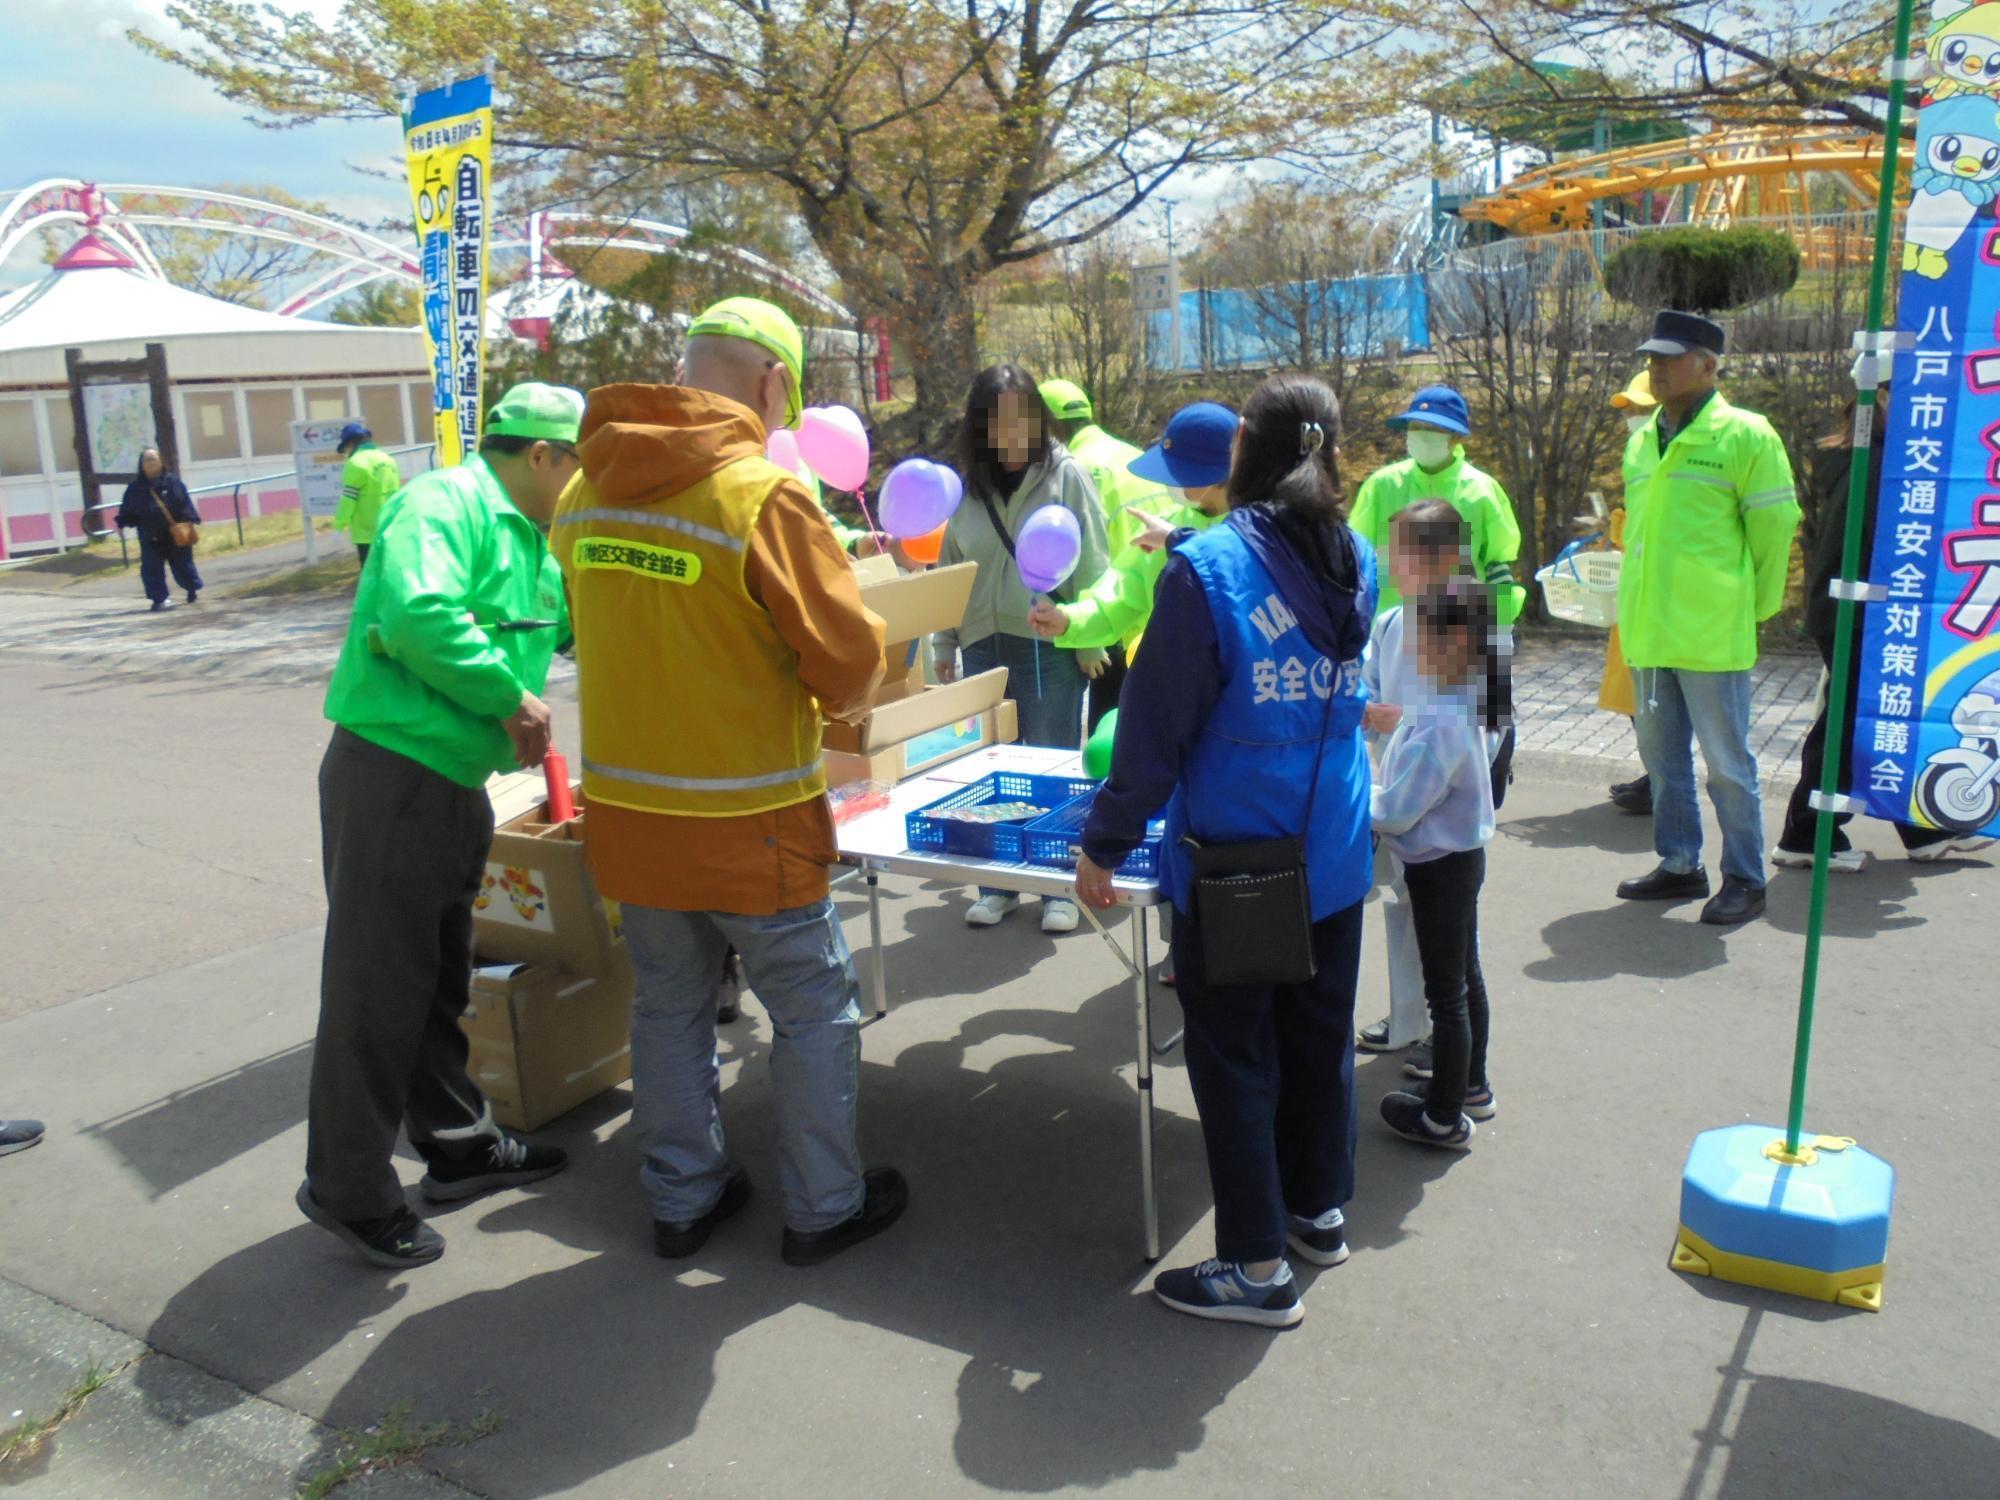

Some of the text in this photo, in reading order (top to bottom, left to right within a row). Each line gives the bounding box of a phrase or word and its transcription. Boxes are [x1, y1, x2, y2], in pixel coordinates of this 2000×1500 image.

[577, 544, 688, 578] 地区交通安全協会
[1869, 305, 1953, 795] 八戸市交通安全対策協議会
[1247, 593, 1299, 646] KA
[1252, 656, 1307, 705] 安全
[1210, 1274, 1245, 1302] N
